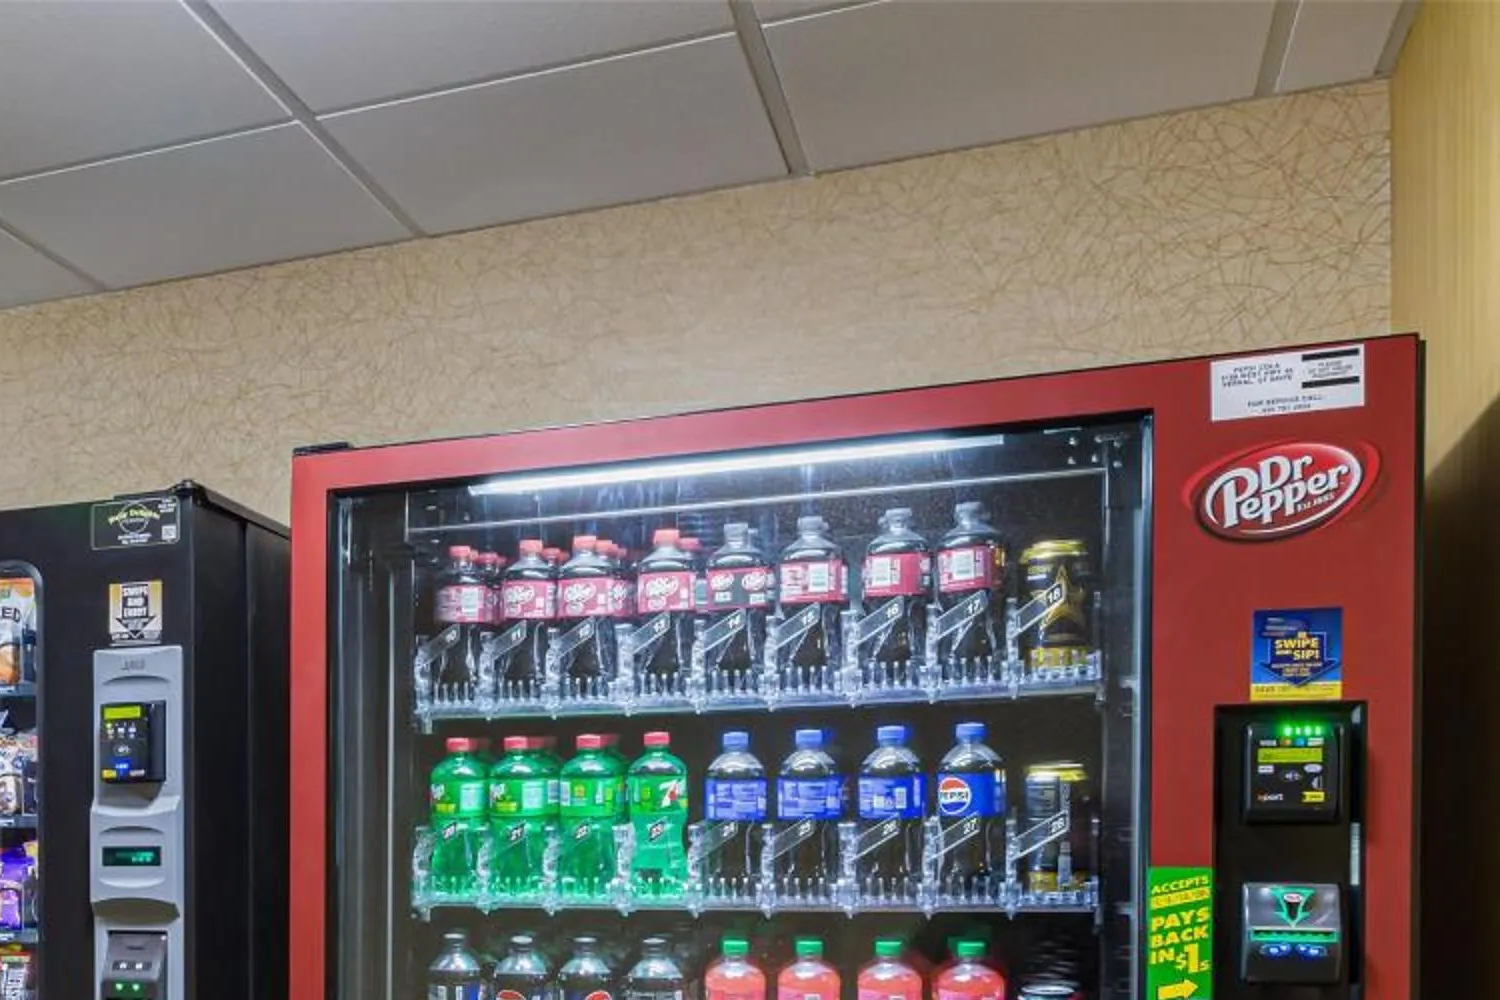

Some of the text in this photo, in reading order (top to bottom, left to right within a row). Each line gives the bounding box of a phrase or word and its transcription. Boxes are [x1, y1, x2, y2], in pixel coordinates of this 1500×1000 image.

[1260, 455, 1312, 492] Dr
[1206, 465, 1349, 528] Pepper
[1274, 637, 1320, 649] SWIPE
[1151, 875, 1209, 895] ACCEPTS
[1152, 906, 1210, 932] PAYS
[1151, 924, 1209, 949] BACK
[1150, 946, 1175, 965] IN
